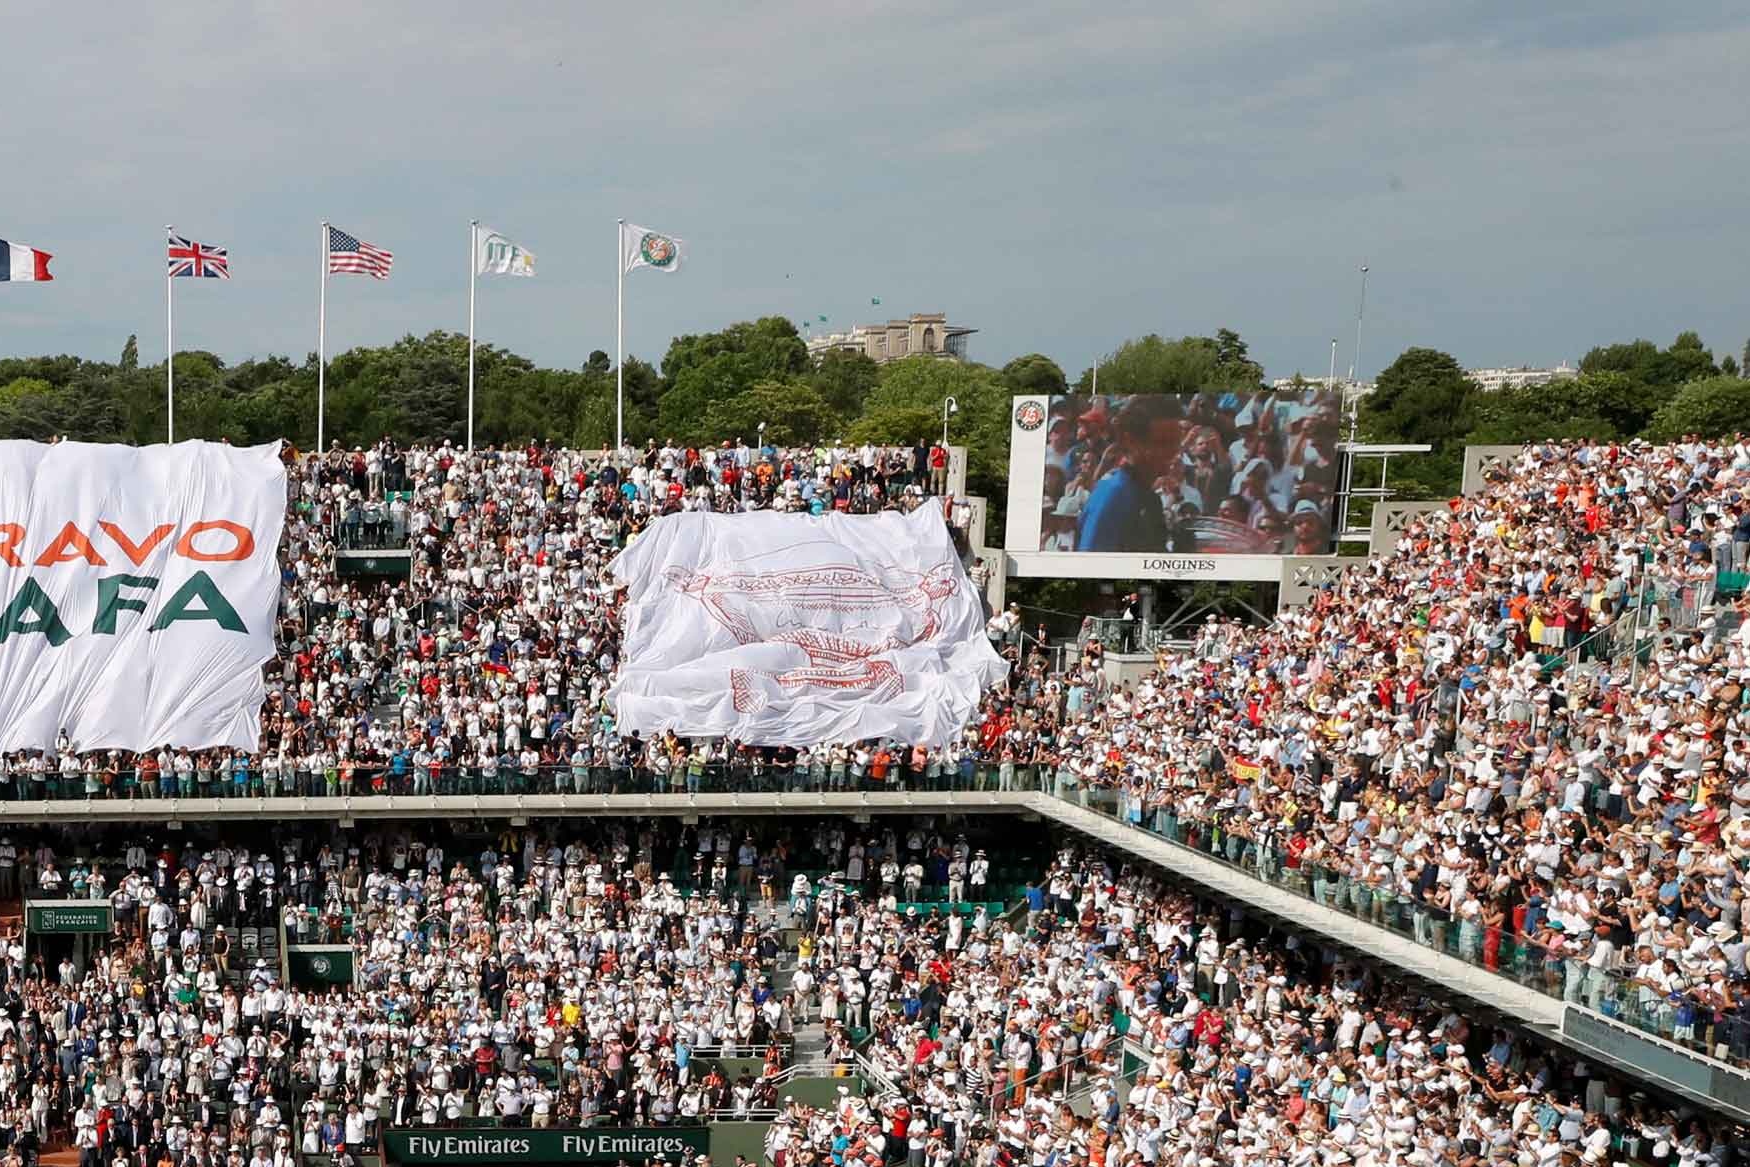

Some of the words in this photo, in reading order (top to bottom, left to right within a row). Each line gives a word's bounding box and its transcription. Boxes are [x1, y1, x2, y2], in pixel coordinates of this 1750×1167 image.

[1143, 559, 1217, 570] LONGINES
[408, 1136, 441, 1158] Fly
[444, 1135, 530, 1154] Emirates
[563, 1135, 595, 1157] Fly
[598, 1134, 684, 1153] Emirates
